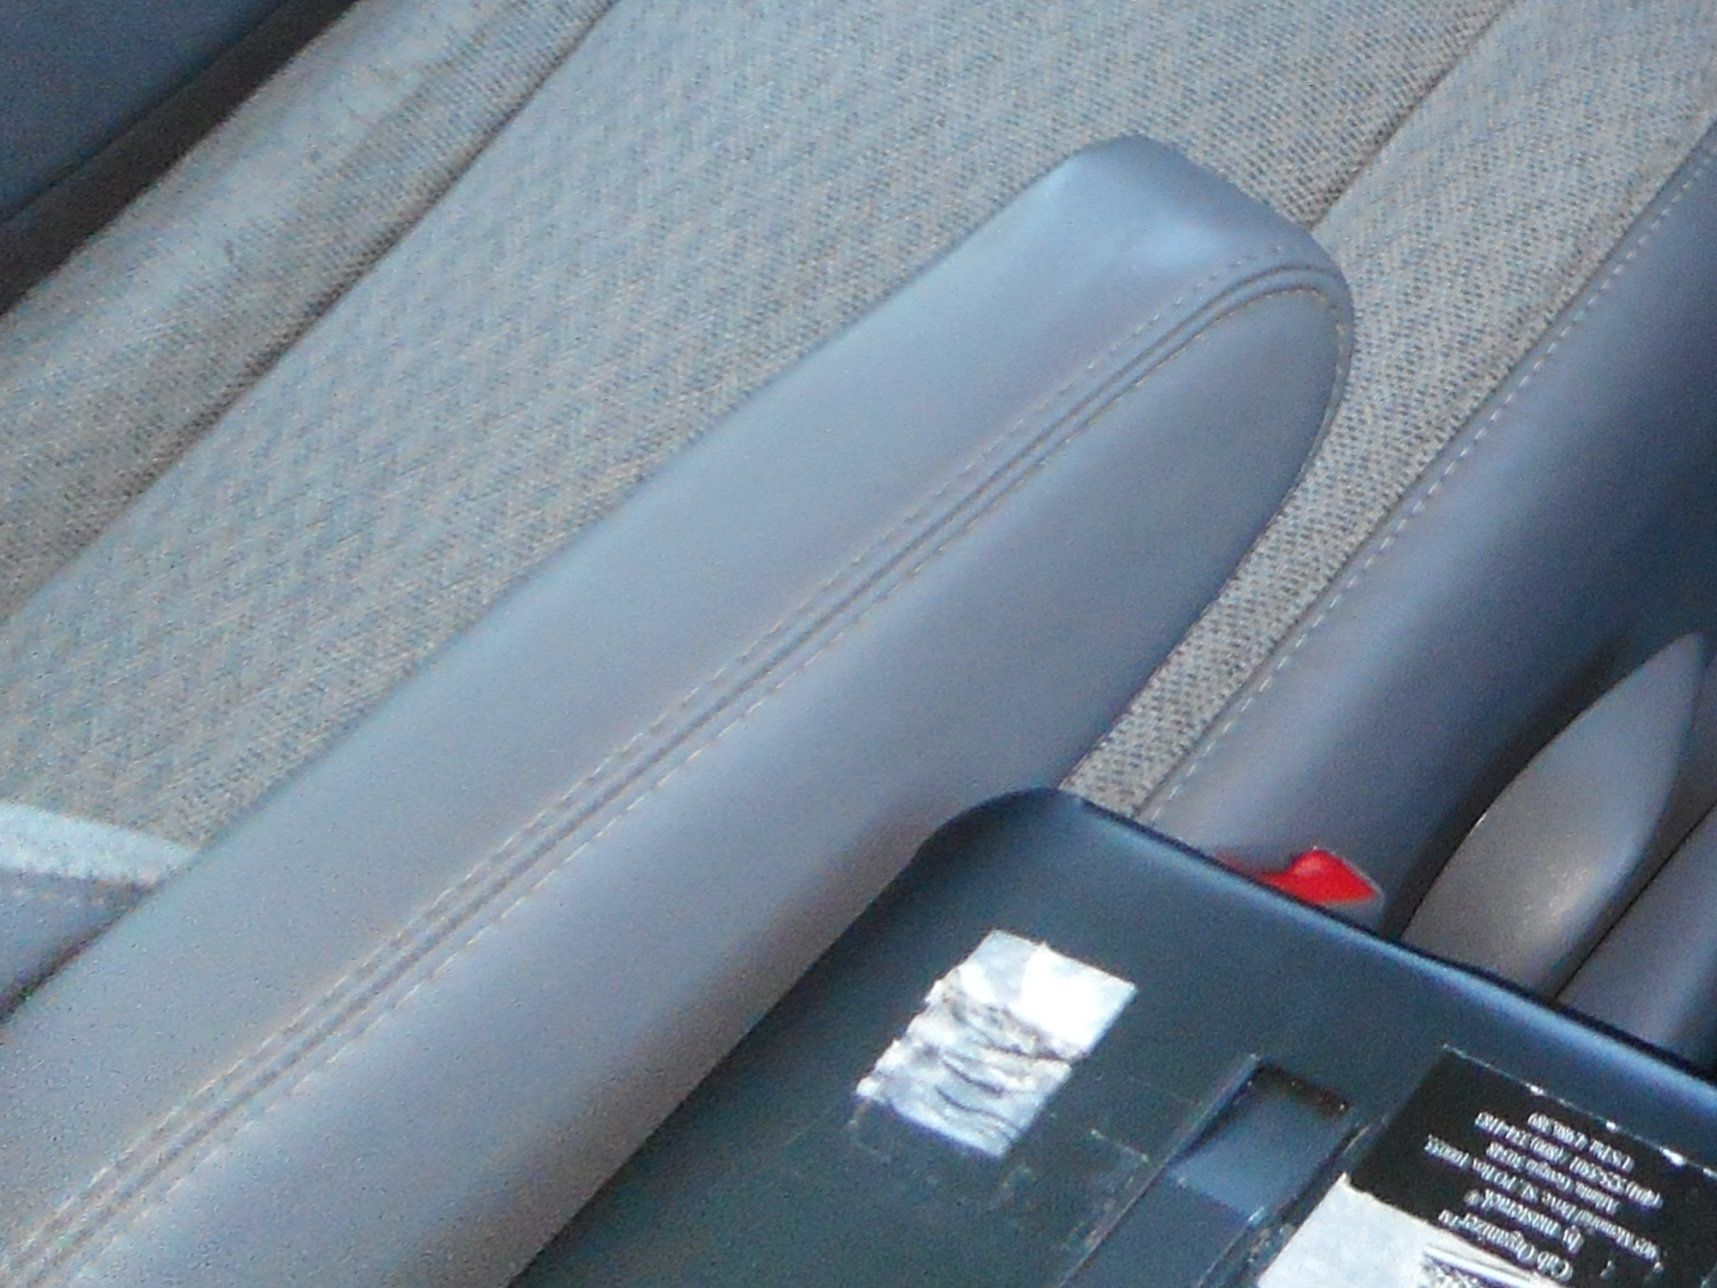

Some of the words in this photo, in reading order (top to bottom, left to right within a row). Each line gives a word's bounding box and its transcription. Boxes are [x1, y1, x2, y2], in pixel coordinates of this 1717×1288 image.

[1525, 1159, 1575, 1192] Georgia
[1562, 1225, 1585, 1253] by
[1537, 1251, 1573, 1282] Cab
